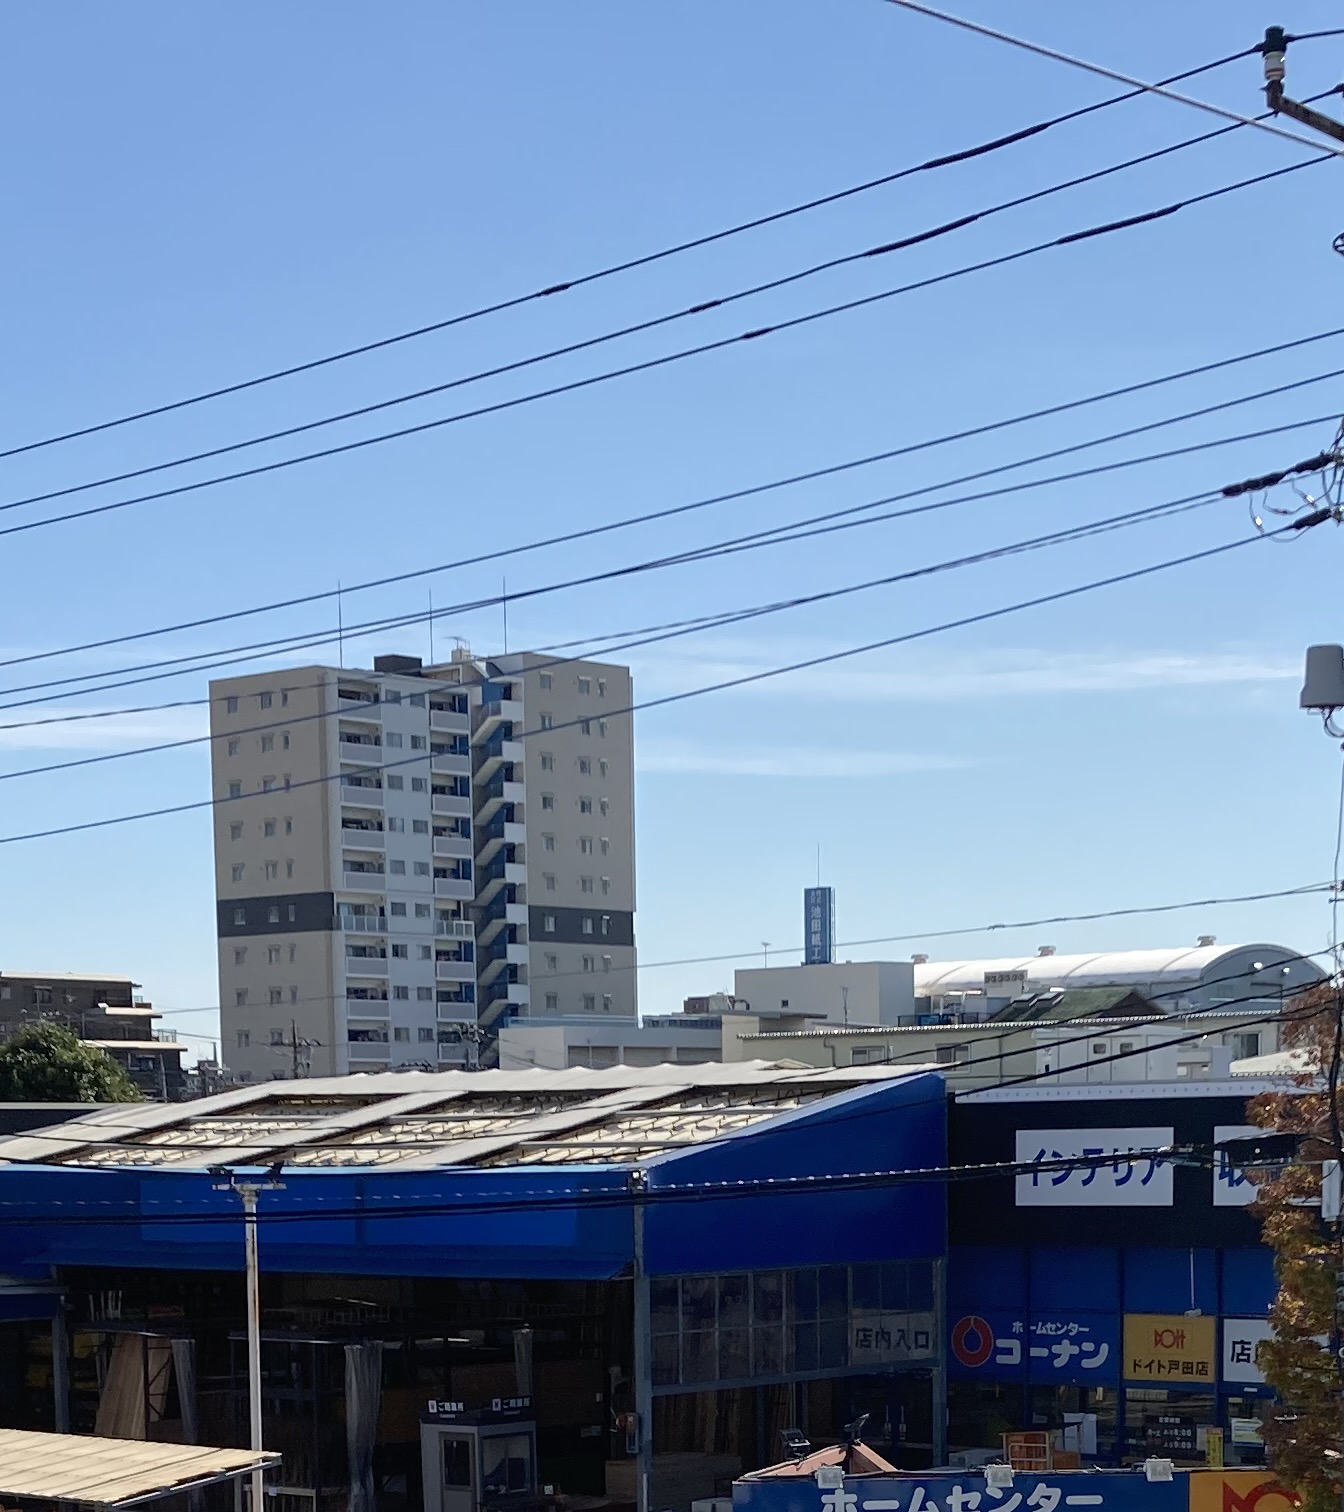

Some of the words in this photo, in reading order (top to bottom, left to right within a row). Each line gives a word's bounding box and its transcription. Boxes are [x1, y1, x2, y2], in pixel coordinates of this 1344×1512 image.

[855, 1326, 930, 1352] 店内入口
[1011, 1320, 1090, 1336] ホームセンター
[995, 1338, 1109, 1369] コーナン
[1132, 1358, 1209, 1376] ドイト戸田店
